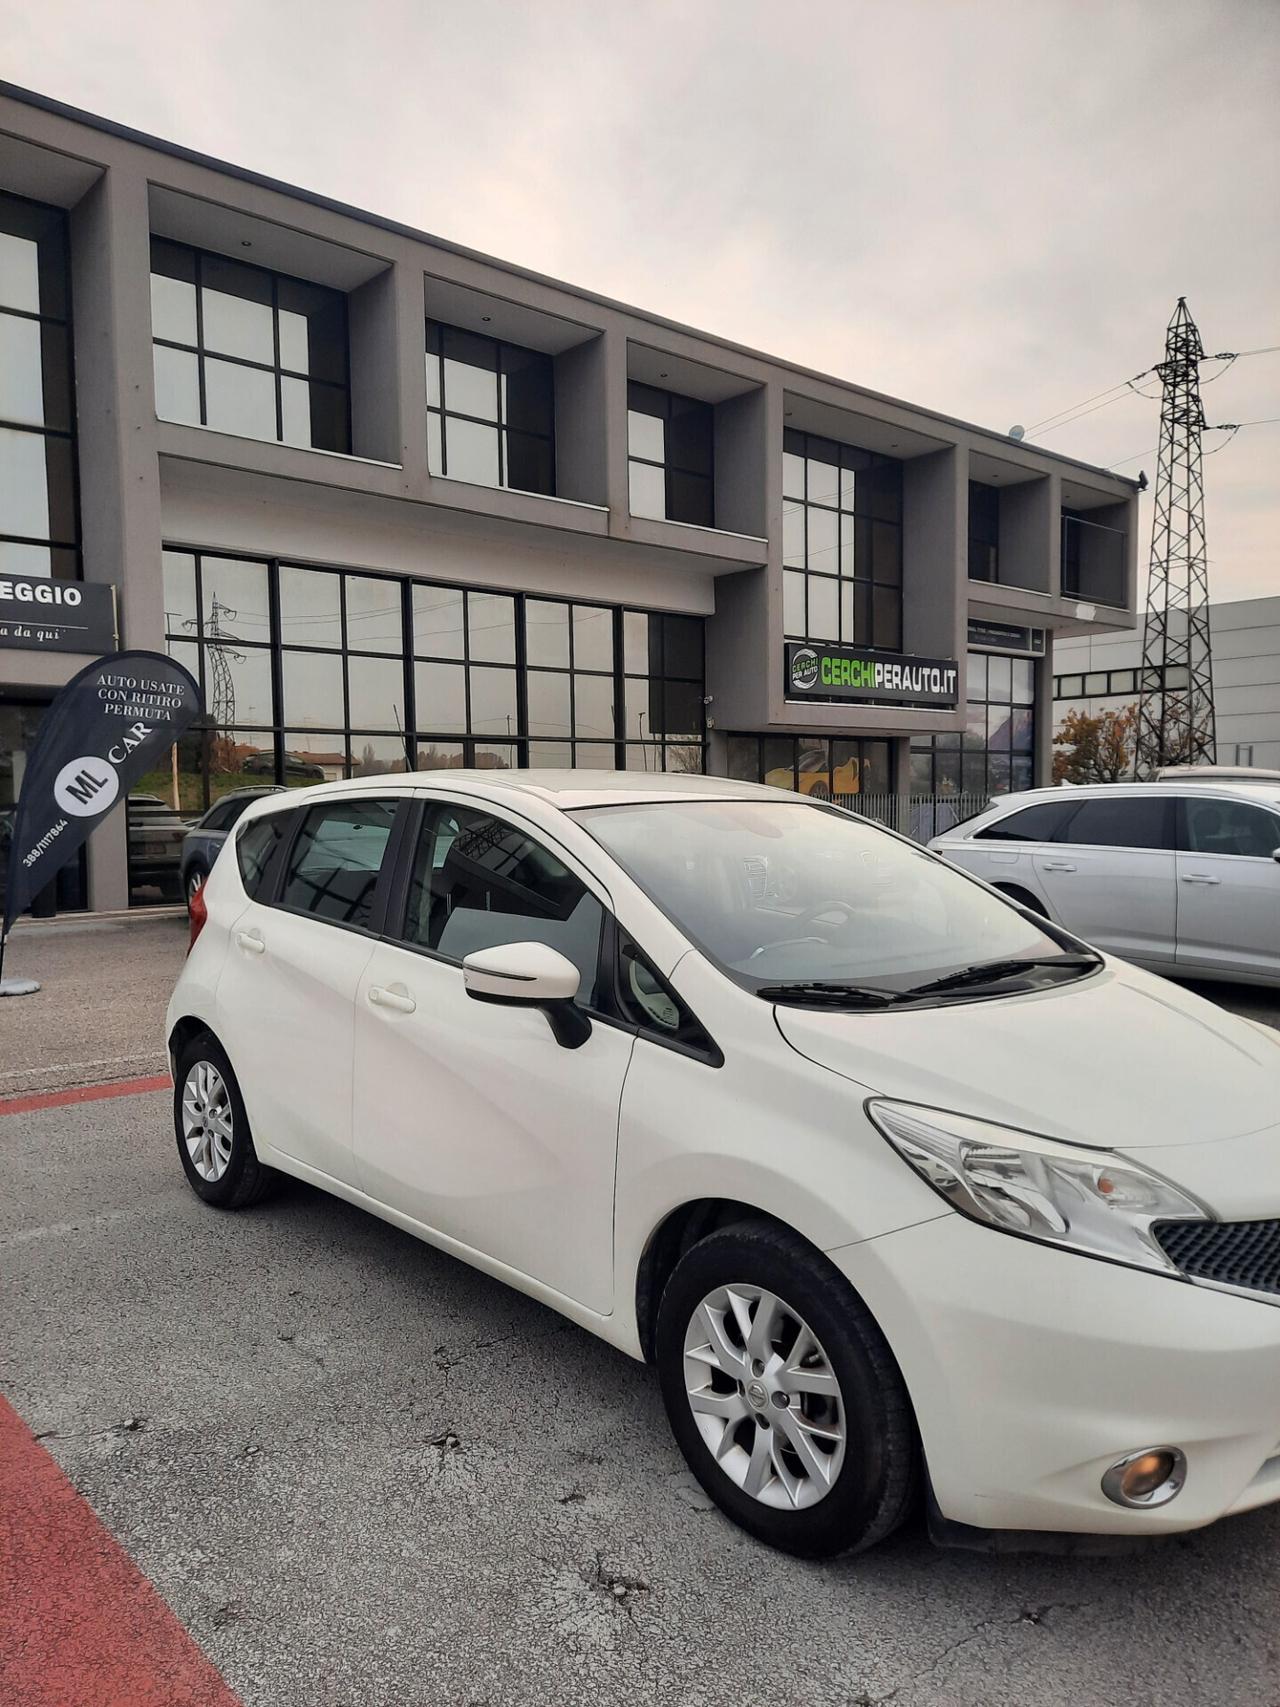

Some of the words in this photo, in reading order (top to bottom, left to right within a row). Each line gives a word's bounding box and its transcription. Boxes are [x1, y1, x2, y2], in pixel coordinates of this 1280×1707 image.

[0, 581, 82, 606] EGGIO
[14, 625, 31, 637] da
[36, 628, 60, 642] qui
[97, 674, 137, 689] AUTO
[140, 679, 185, 696] USATE
[821, 656, 957, 694] CERCHIPERAUTO.IT
[98, 688, 127, 701] CON
[132, 691, 182, 709] RITIRO
[104, 703, 171, 721] PERMUTA
[65, 769, 109, 805] ML
[108, 721, 153, 764] CAR
[22, 819, 69, 868] 388/1117864
